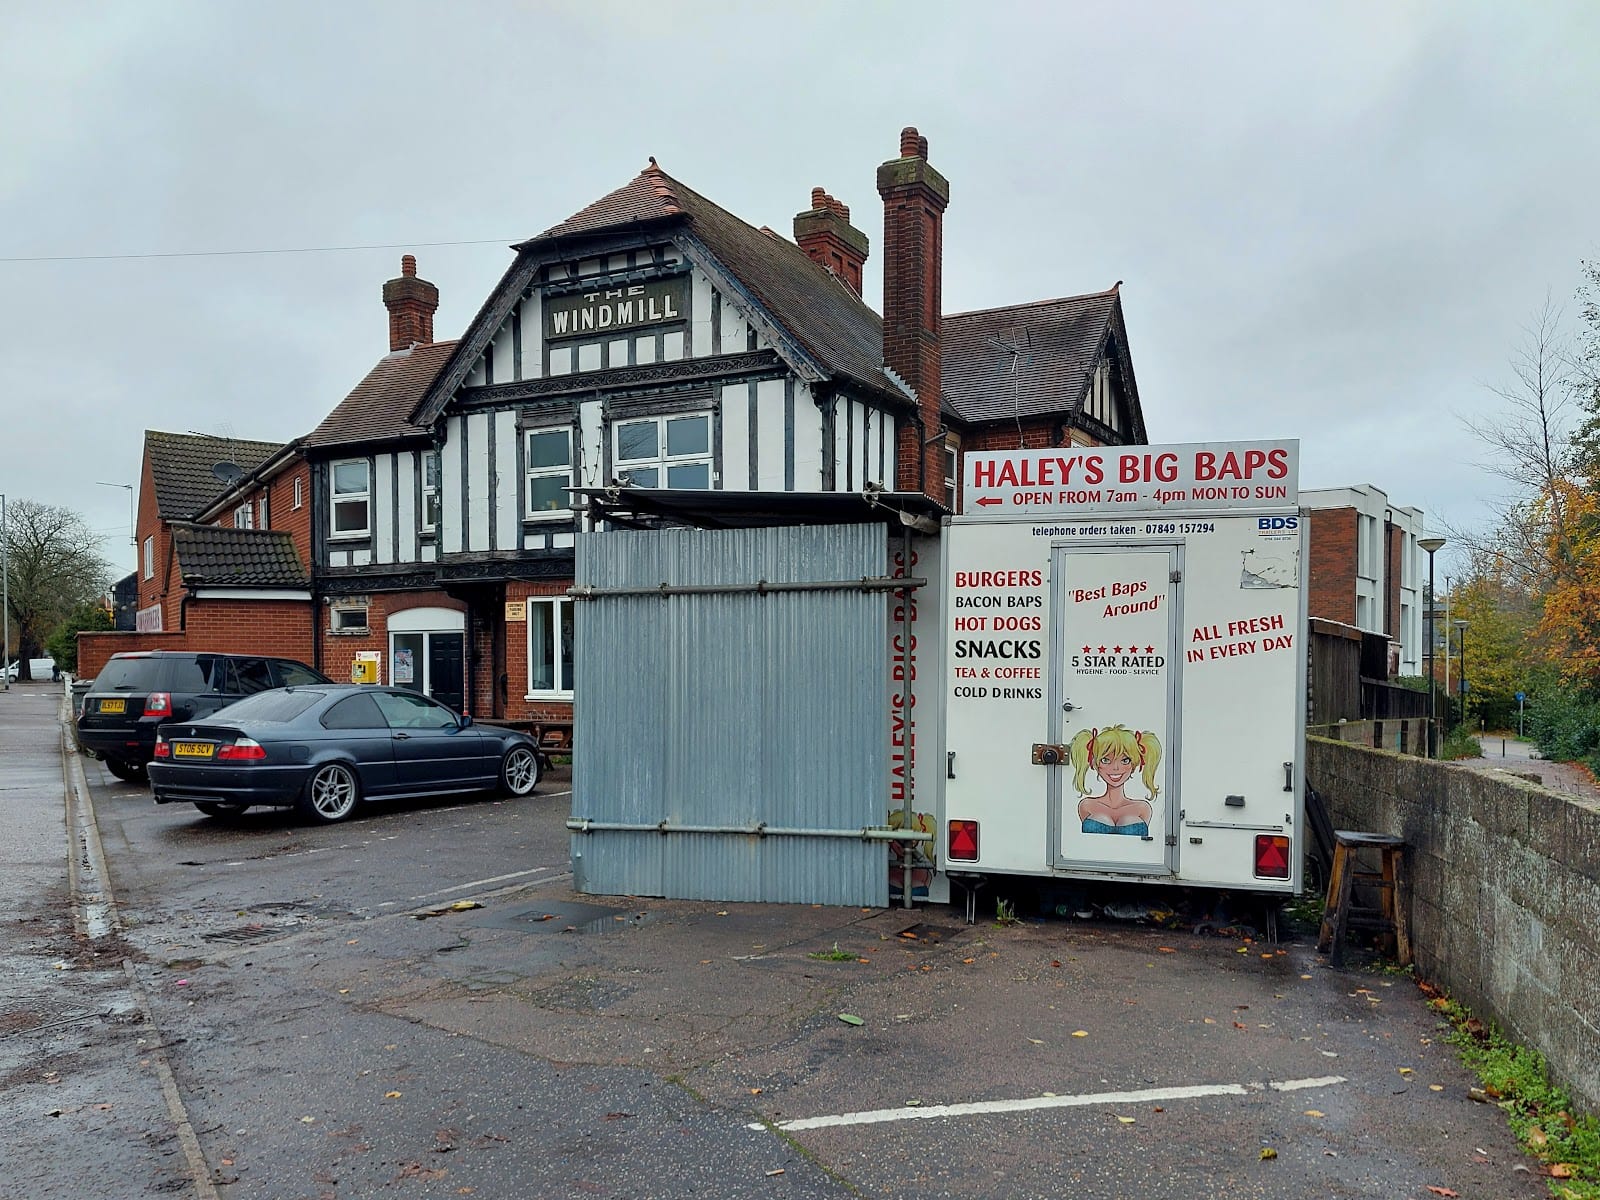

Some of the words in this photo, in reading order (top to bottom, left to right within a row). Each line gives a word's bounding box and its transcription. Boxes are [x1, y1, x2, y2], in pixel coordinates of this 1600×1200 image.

[583, 285, 645, 302] THE
[553, 295, 678, 334] WINDMILL
[974, 456, 1104, 488] HALEY'S
[1119, 454, 1178, 484] BIG
[1194, 450, 1288, 481] BAPS
[1012, 492, 1053, 506] OPEN
[1059, 491, 1101, 504] FROM
[1106, 490, 1137, 503] 7am
[1152, 489, 1186, 505] 4pm
[1192, 488, 1228, 500] MON
[1230, 487, 1250, 500] TO
[1255, 486, 1287, 499] SUN
[1032, 527, 1077, 537] telephone
[1079, 526, 1107, 536] orders
[1109, 525, 1136, 535] taken
[1145, 524, 1176, 535] 07849
[1178, 524, 1215, 534] 157294
[1258, 517, 1298, 530] BDS
[955, 571, 1042, 588] BURGERS
[1068, 587, 1107, 603] "Best
[1110, 581, 1148, 598] Baps
[955, 597, 1002, 608] BACON
[1007, 596, 1042, 608] BAPS
[1102, 594, 1165, 618] Around"
[955, 617, 988, 631] HOT
[993, 617, 1041, 631] DOGS
[1192, 626, 1223, 643] ALL
[1227, 615, 1285, 635] FRESH
[954, 640, 1041, 659] SNACKS
[1186, 649, 1209, 664] IN
[1209, 641, 1257, 660] EVERY
[1262, 635, 1293, 652] DAY
[1071, 656, 1080, 667] 5
[1084, 656, 1118, 668] STAR
[1121, 656, 1165, 668] RATED
[954, 668, 977, 678] TEA
[979, 667, 991, 680] &
[994, 668, 1041, 679] COFFEE
[954, 687, 988, 698] COLD
[992, 688, 1042, 699] DRINKS
[178, 744, 196, 753] ST06
[196, 744, 211, 754] SCV
